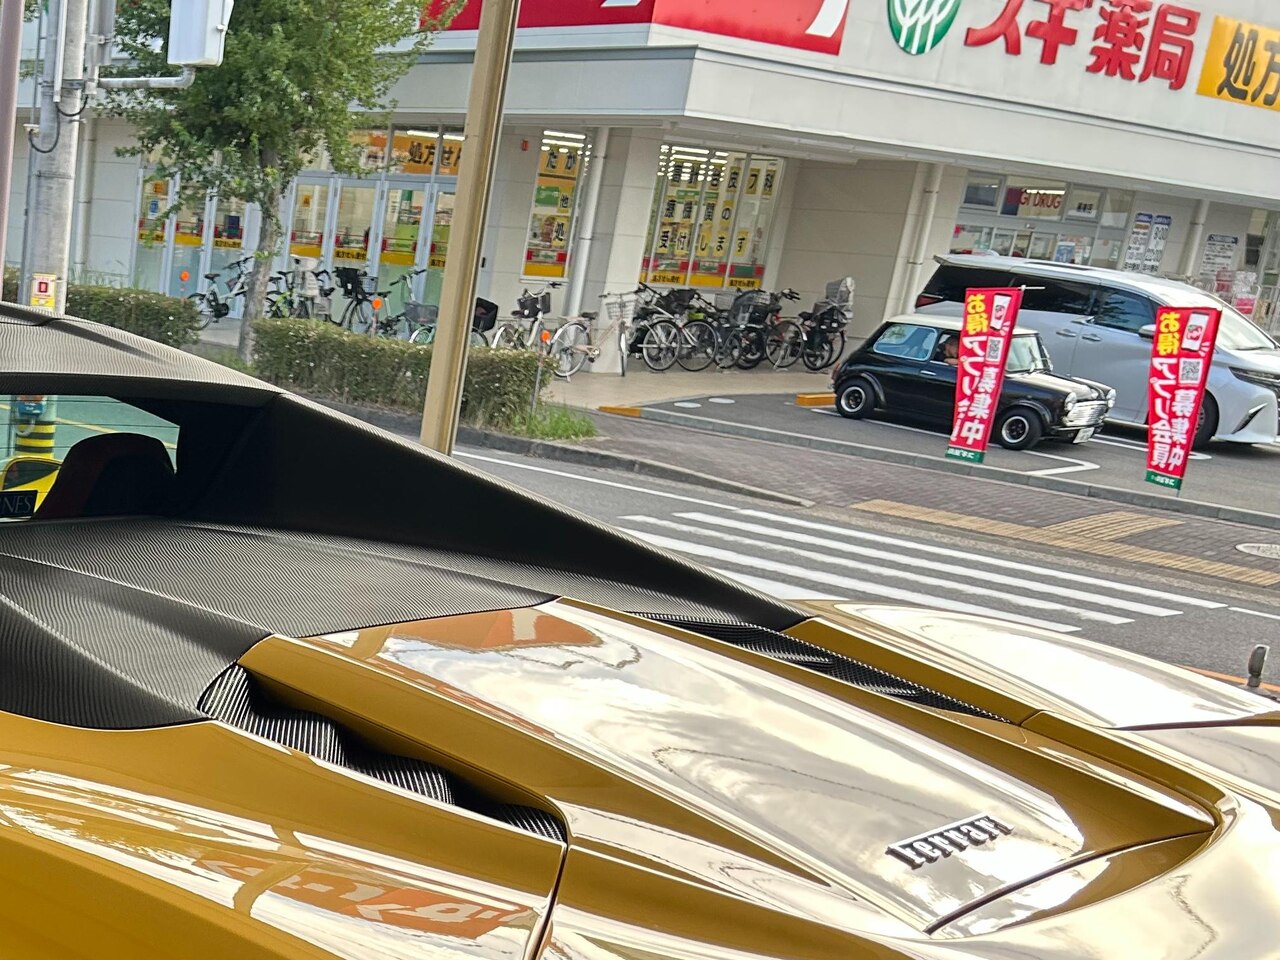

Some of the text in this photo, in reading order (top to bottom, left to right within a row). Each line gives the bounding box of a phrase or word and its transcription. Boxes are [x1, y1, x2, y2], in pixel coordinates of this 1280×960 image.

[964, 0, 1201, 91] スギ薬局
[884, 811, 1015, 870] Ferrari
